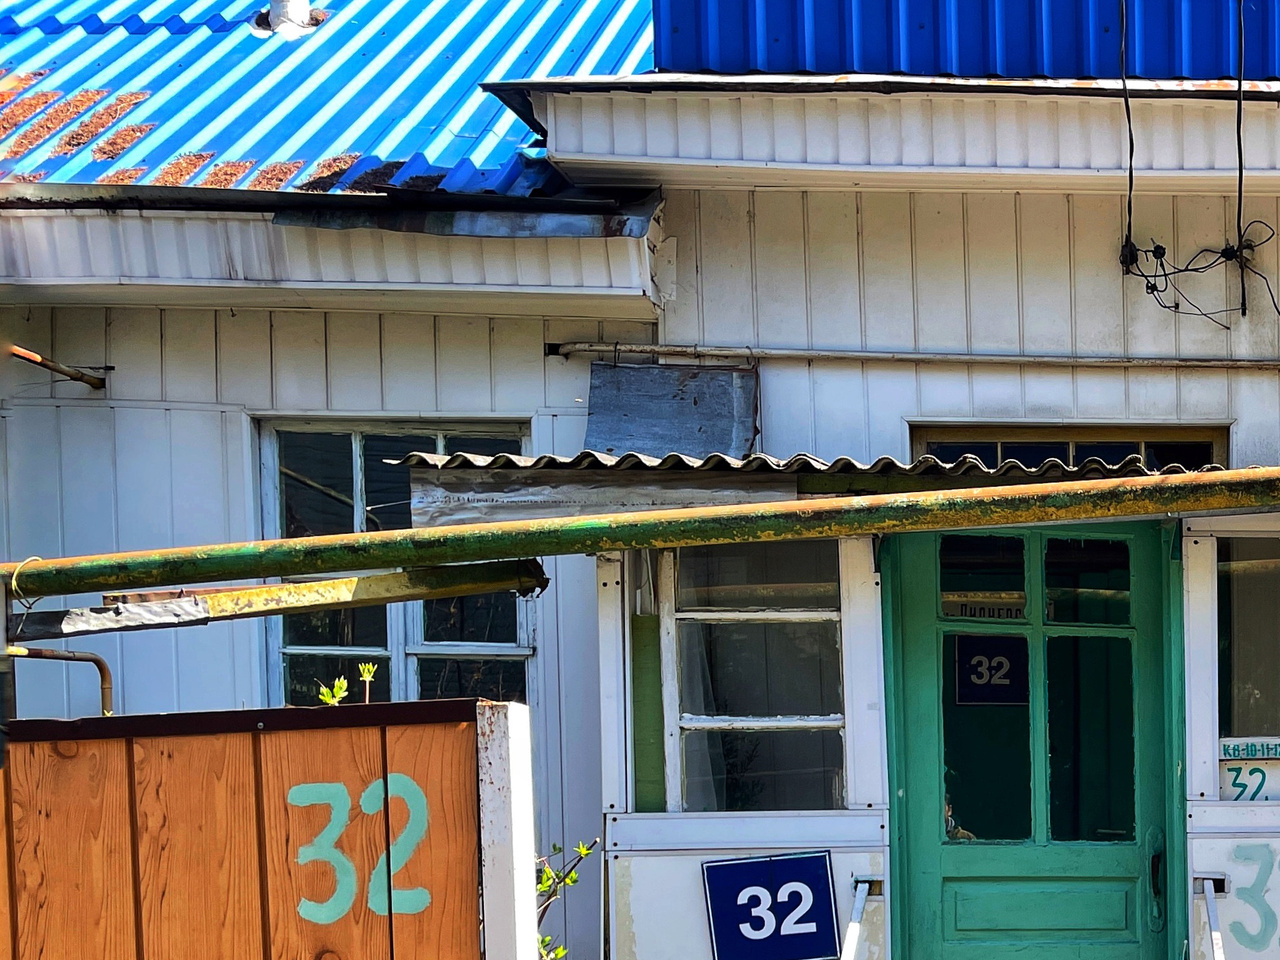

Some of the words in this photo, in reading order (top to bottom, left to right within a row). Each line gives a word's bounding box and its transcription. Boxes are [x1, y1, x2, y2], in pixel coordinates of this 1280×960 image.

[970, 655, 1011, 685] 32
[1227, 766, 1269, 801] 32
[287, 772, 432, 924] 32
[738, 881, 818, 942] 32
